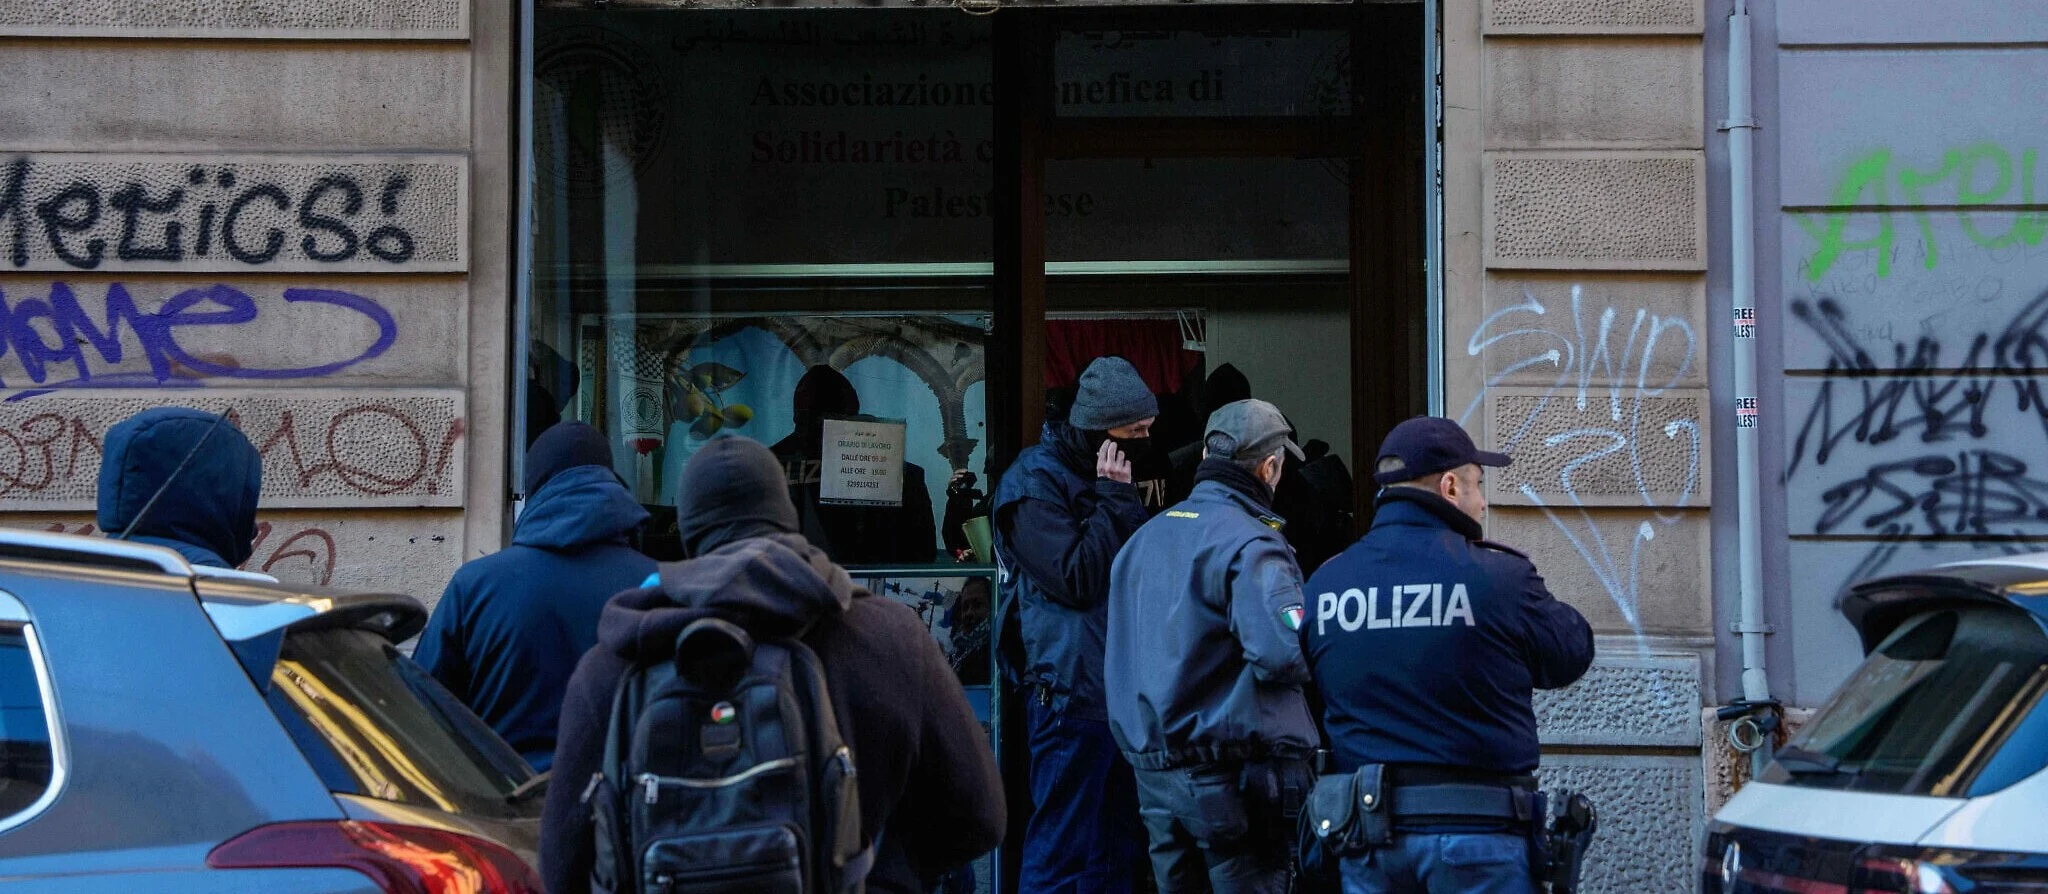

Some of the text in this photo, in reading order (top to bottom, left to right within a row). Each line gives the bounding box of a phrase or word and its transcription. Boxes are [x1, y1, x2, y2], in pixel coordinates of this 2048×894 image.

[750, 68, 1223, 106] Associazione nefica di
[752, 129, 963, 163] Solidarietà
[1734, 308, 1756, 319] REE
[1736, 398, 1758, 409] REE
[869, 442, 891, 450] LAVORO
[841, 453, 858, 461] DALLE
[860, 454, 871, 462] ORE
[840, 467, 854, 475] ALLE
[854, 467, 867, 475] ORE
[1317, 583, 1476, 636] POLIZIA
